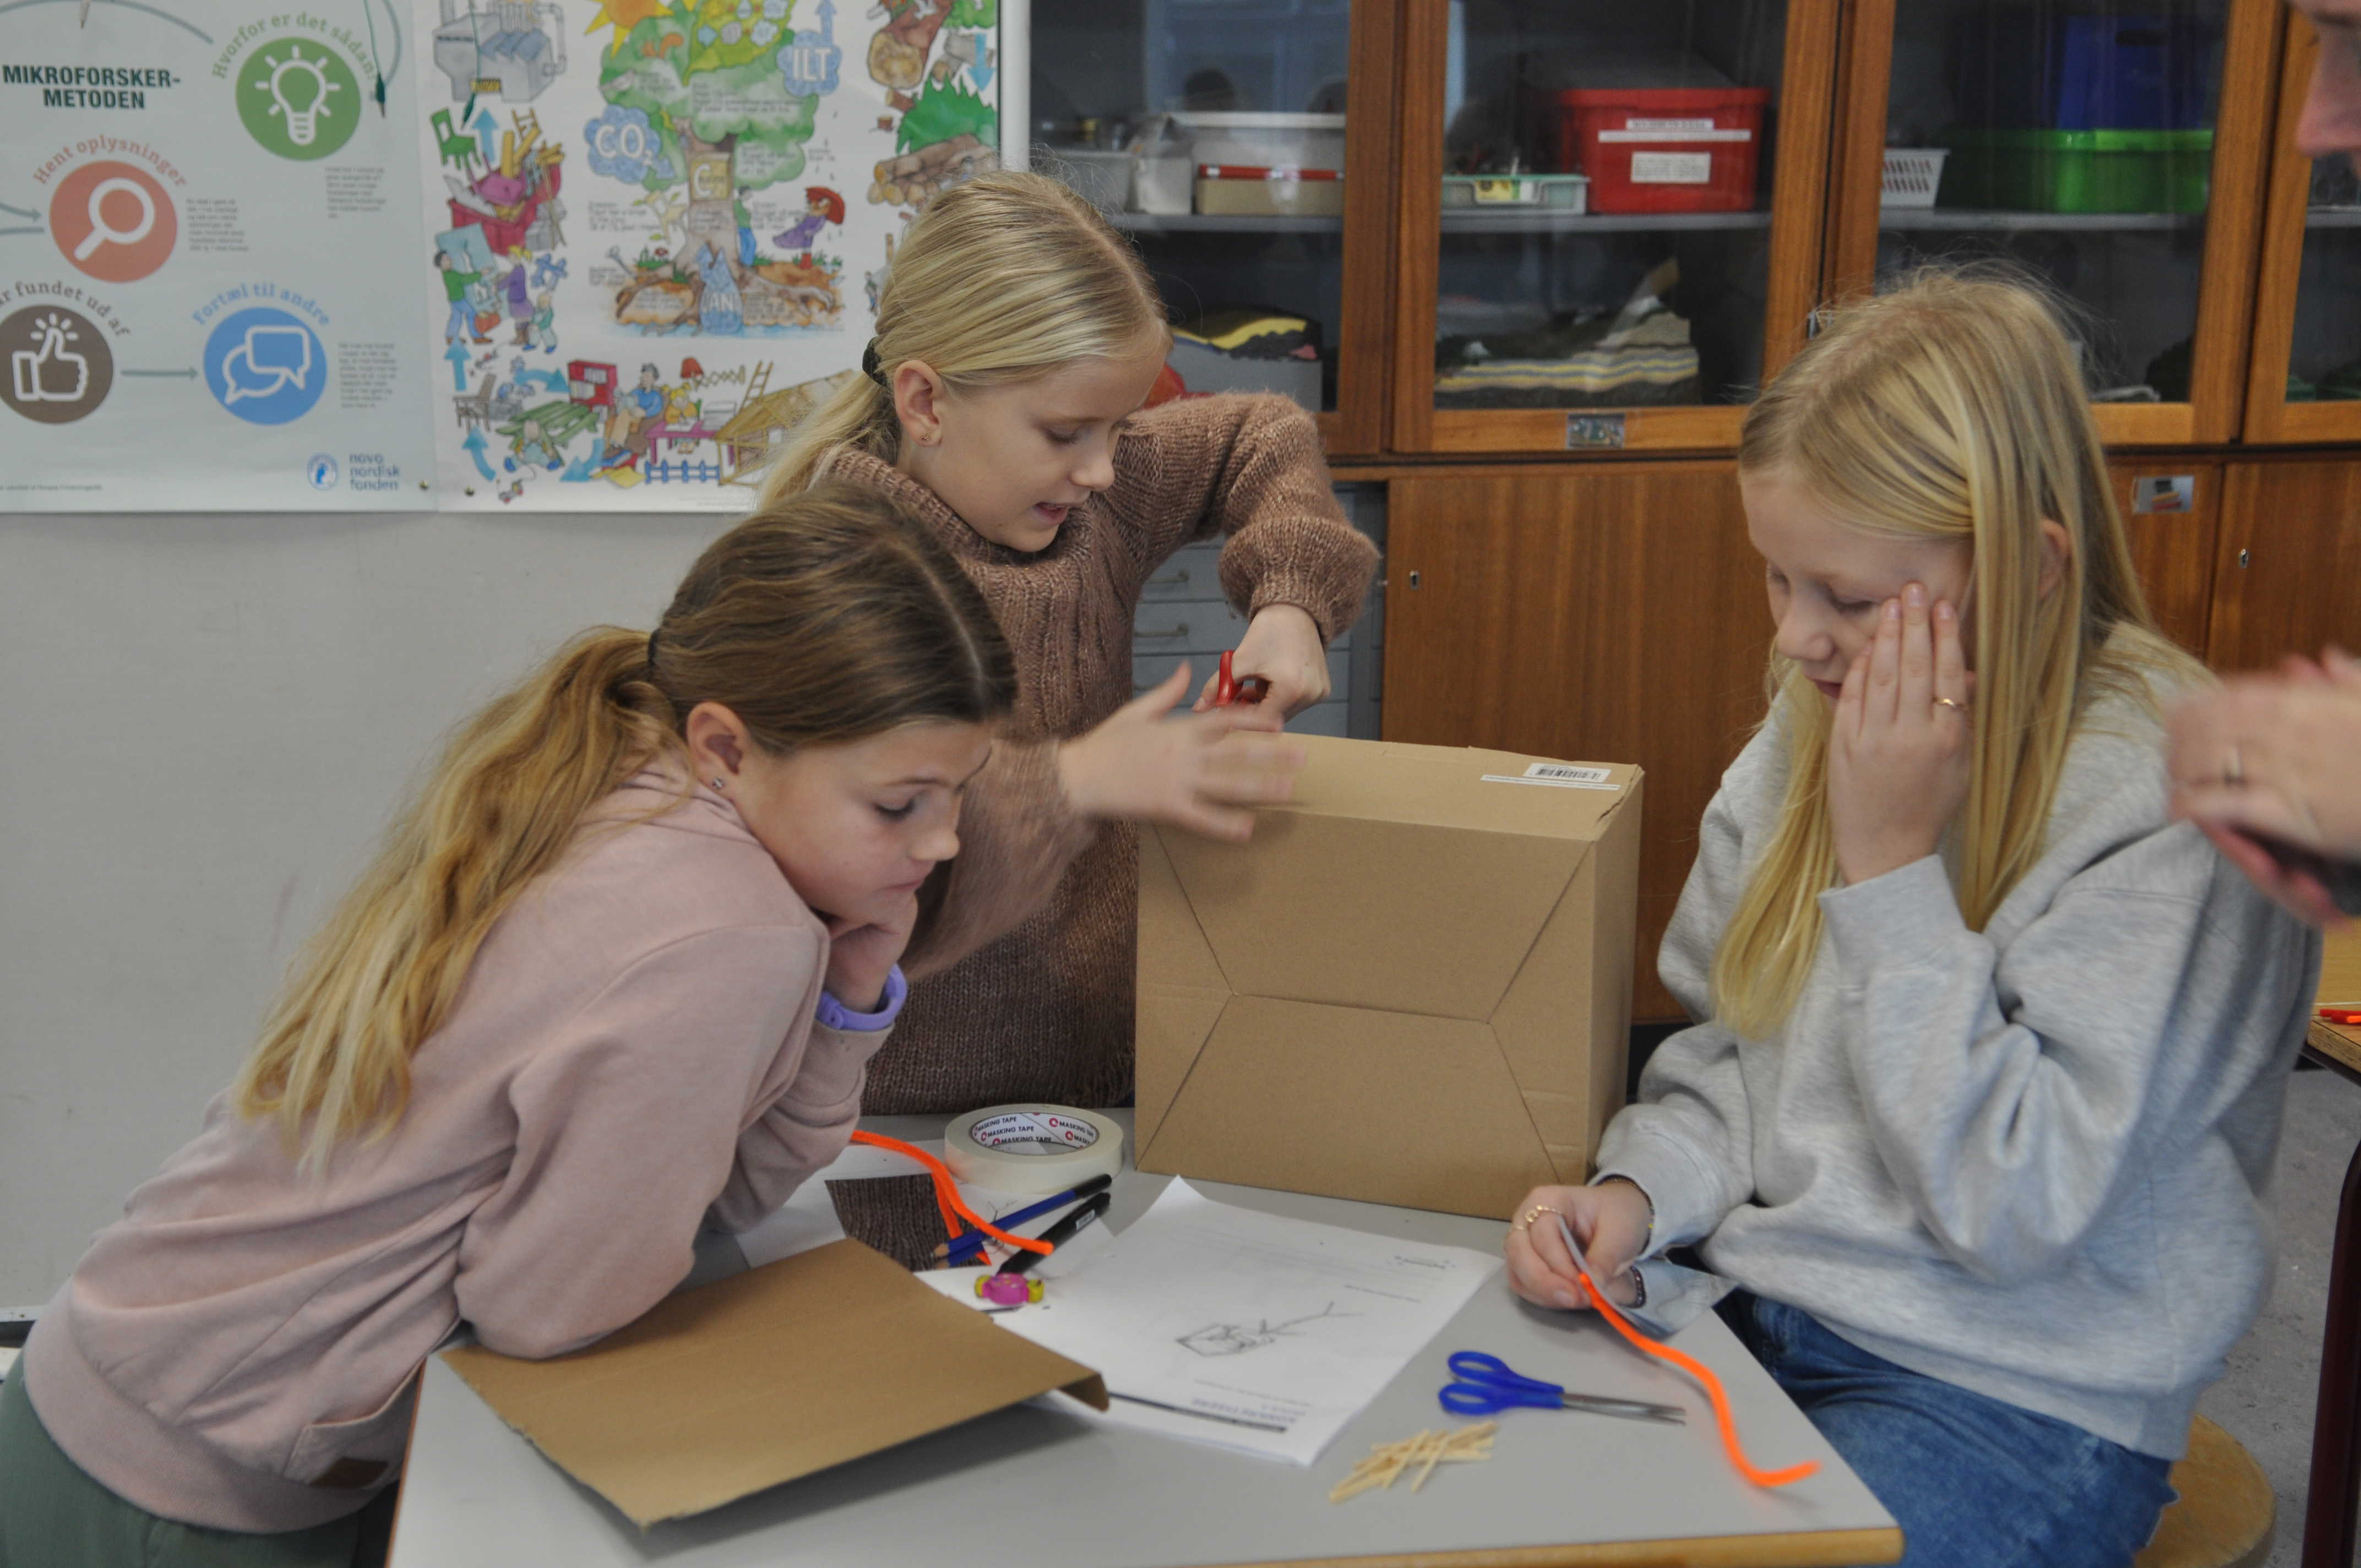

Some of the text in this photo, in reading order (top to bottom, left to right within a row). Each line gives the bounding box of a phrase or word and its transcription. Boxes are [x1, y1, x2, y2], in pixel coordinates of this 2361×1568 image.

[211, 18, 265, 79] Hvorfor
[271, 14, 290, 27] er
[296, 11, 328, 32] det
[794, 47, 831, 80] ILT
[2, 64, 181, 88] MIKROFORSKER-
[43, 89, 145, 109] METODEN
[33, 134, 186, 186] Hent oplysninger
[15, 280, 83, 301] fundet
[86, 296, 111, 318] ud
[108, 318, 131, 336] af
[193, 282, 329, 325] Fortæl til andre
[349, 453, 384, 463] novo
[350, 479, 398, 490] fonden
[978, 1119, 1000, 1131] MASKING
[988, 1127, 1016, 1137] MASKING
[1059, 1121, 1086, 1133] MASKING
